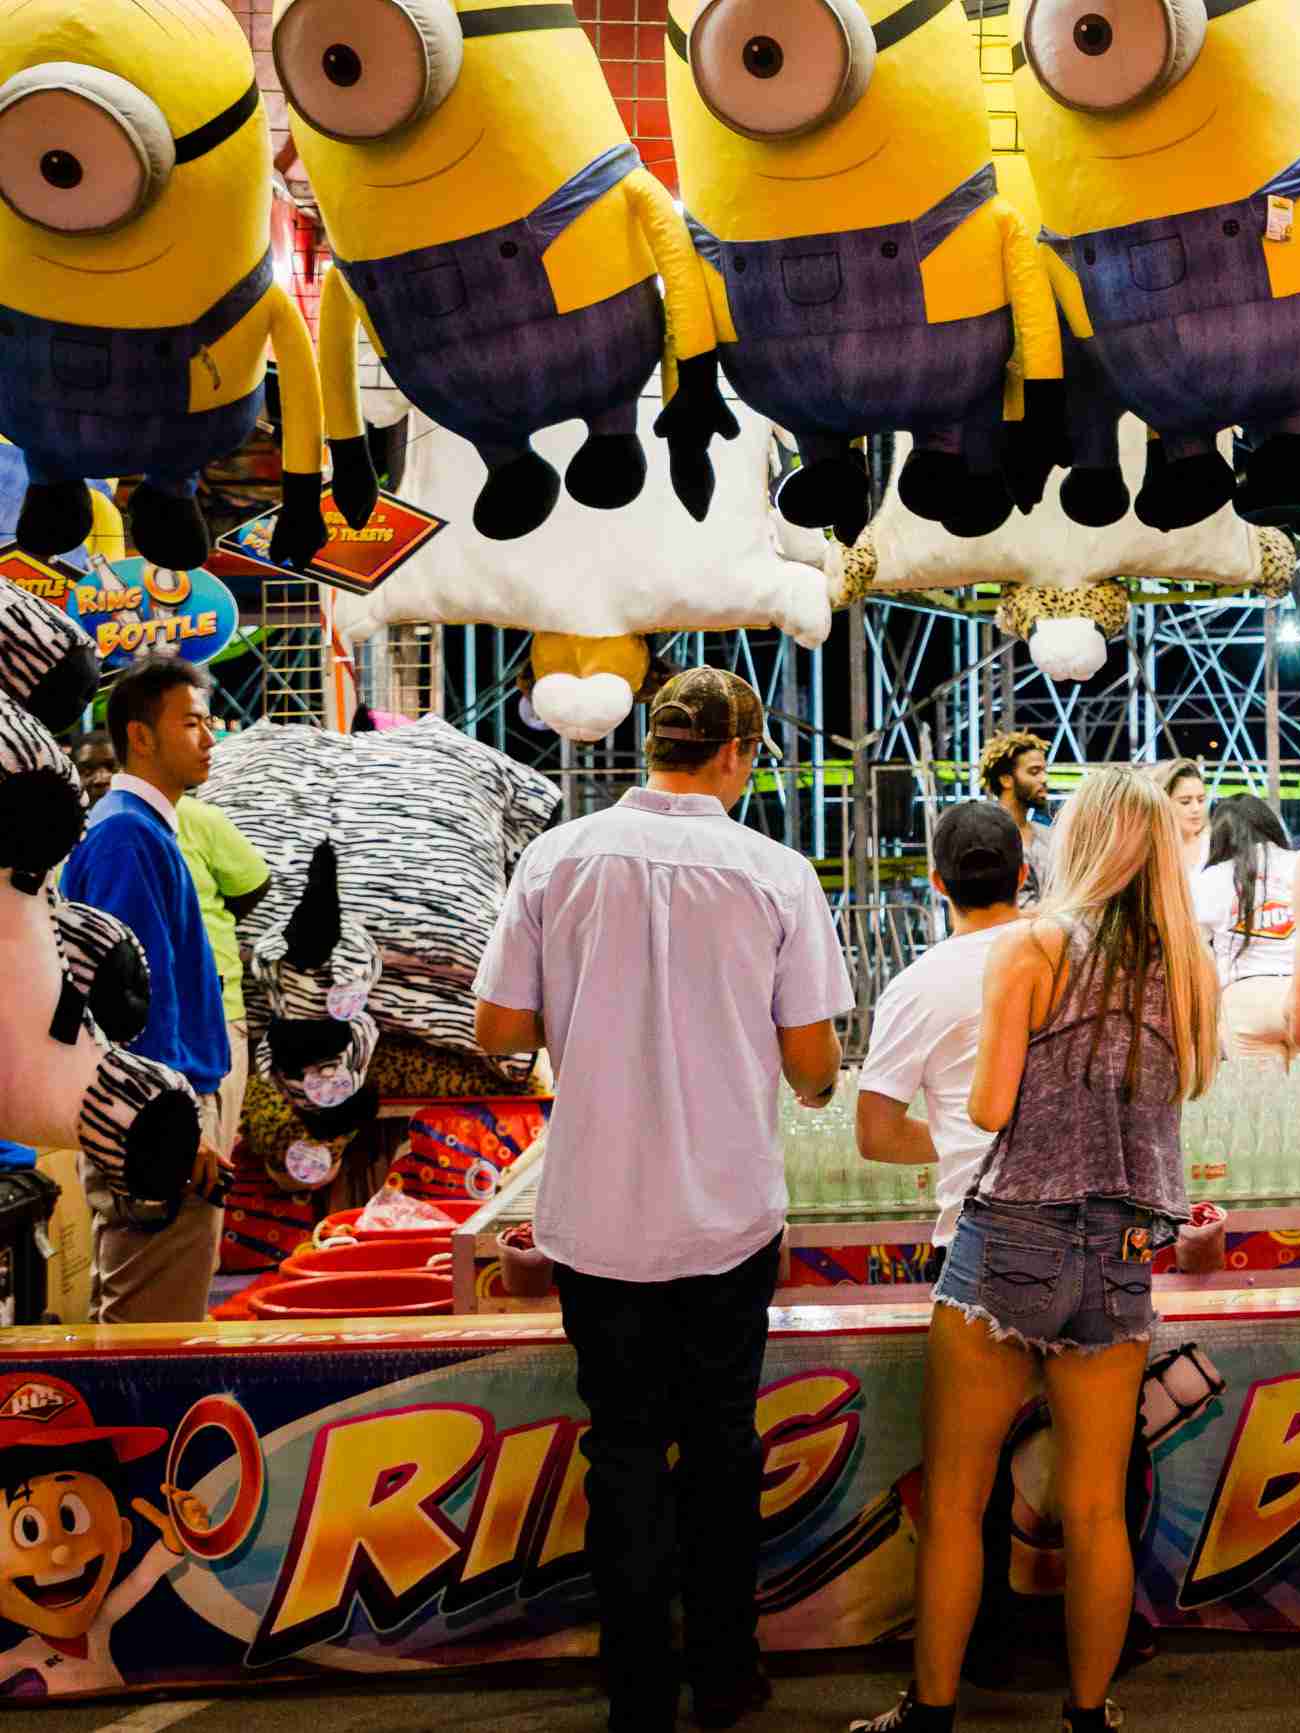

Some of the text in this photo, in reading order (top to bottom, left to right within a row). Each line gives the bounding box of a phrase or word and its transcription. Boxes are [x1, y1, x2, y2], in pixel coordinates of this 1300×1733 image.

[341, 527, 394, 542] TICKETS
[76, 586, 142, 614] RING
[97, 611, 217, 658] BOTTLE
